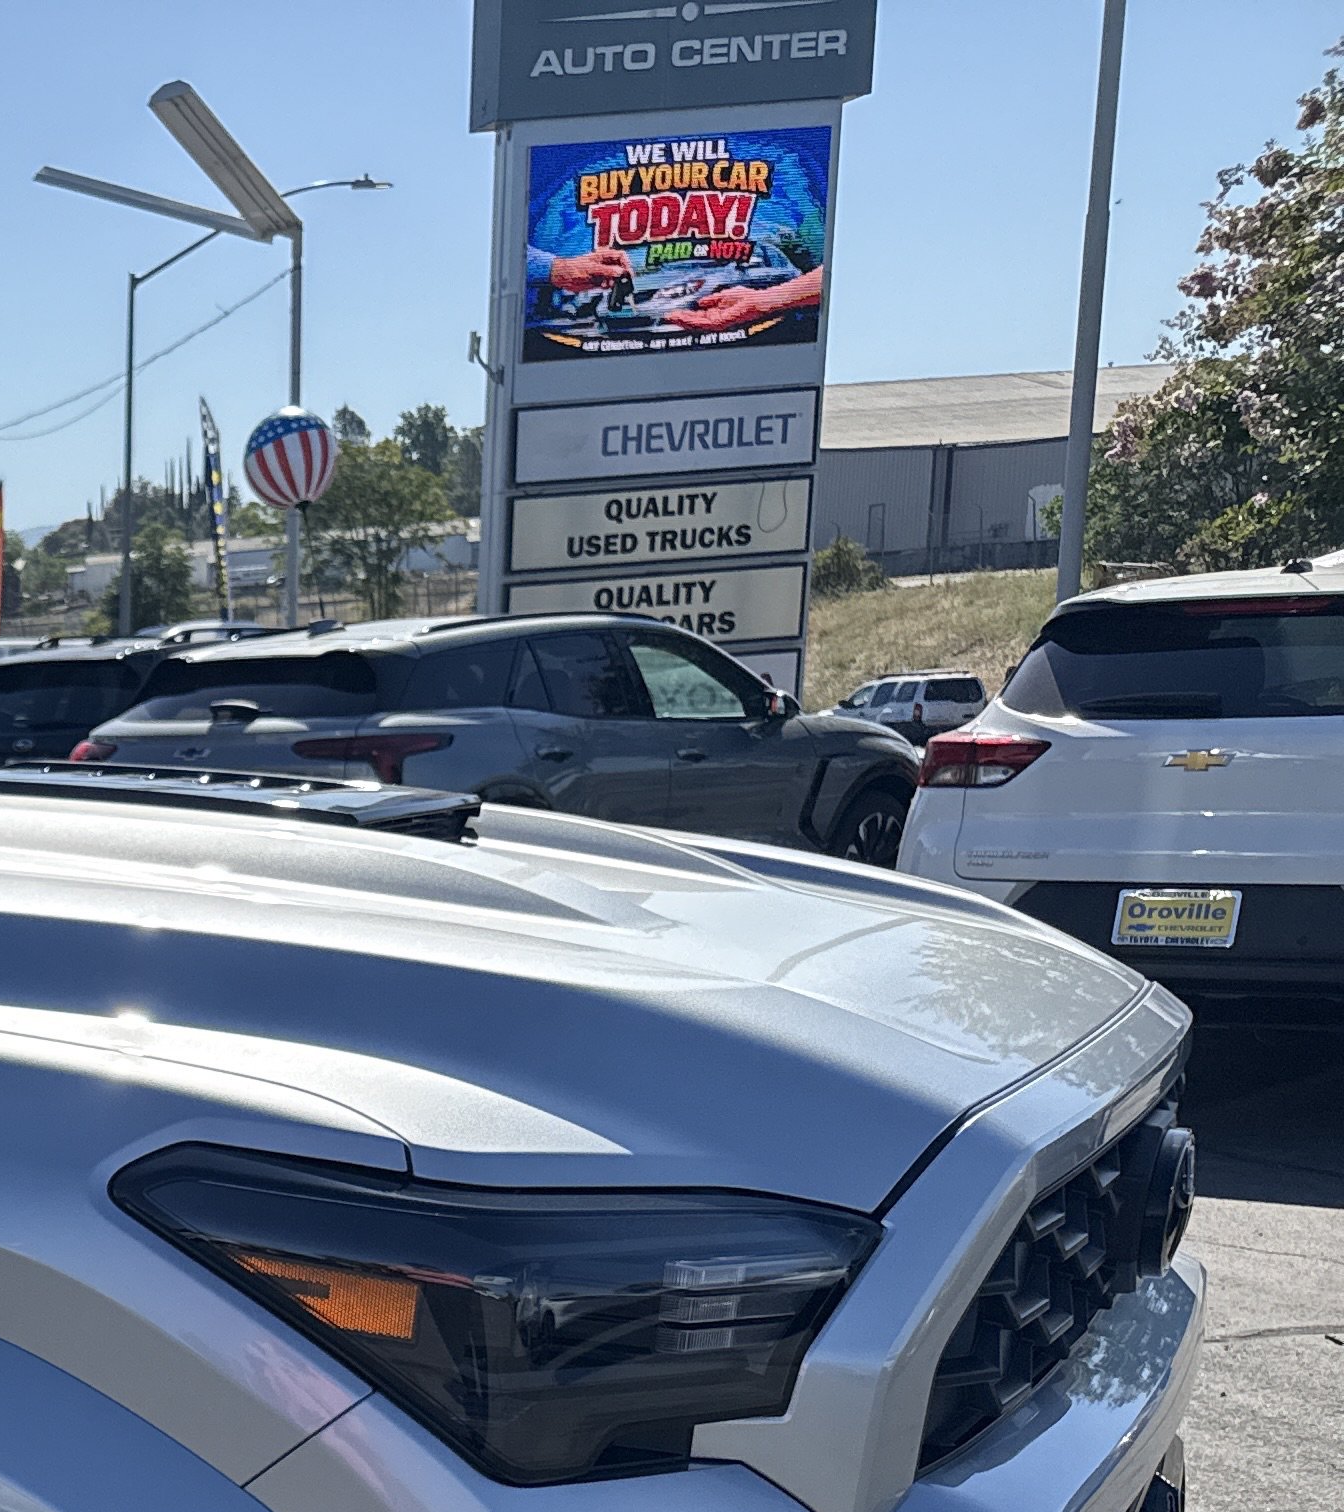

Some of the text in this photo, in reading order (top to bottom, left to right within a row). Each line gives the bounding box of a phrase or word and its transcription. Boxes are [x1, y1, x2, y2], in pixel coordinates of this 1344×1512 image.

[530, 29, 848, 77] AUTO CENTER
[625, 139, 729, 165] WE WILL
[579, 160, 770, 205] BUY YOUR CAR
[588, 192, 756, 249] TODAY!
[647, 241, 693, 264] PAID
[709, 240, 752, 260] NOT!
[600, 412, 798, 458] CHEVROLET
[604, 492, 718, 524] QUALITY
[566, 524, 752, 559] USED TRUCKS
[593, 580, 717, 611] QUALITY
[1127, 902, 1227, 920] Oroville
[1157, 924, 1225, 933] CHEVROLET
